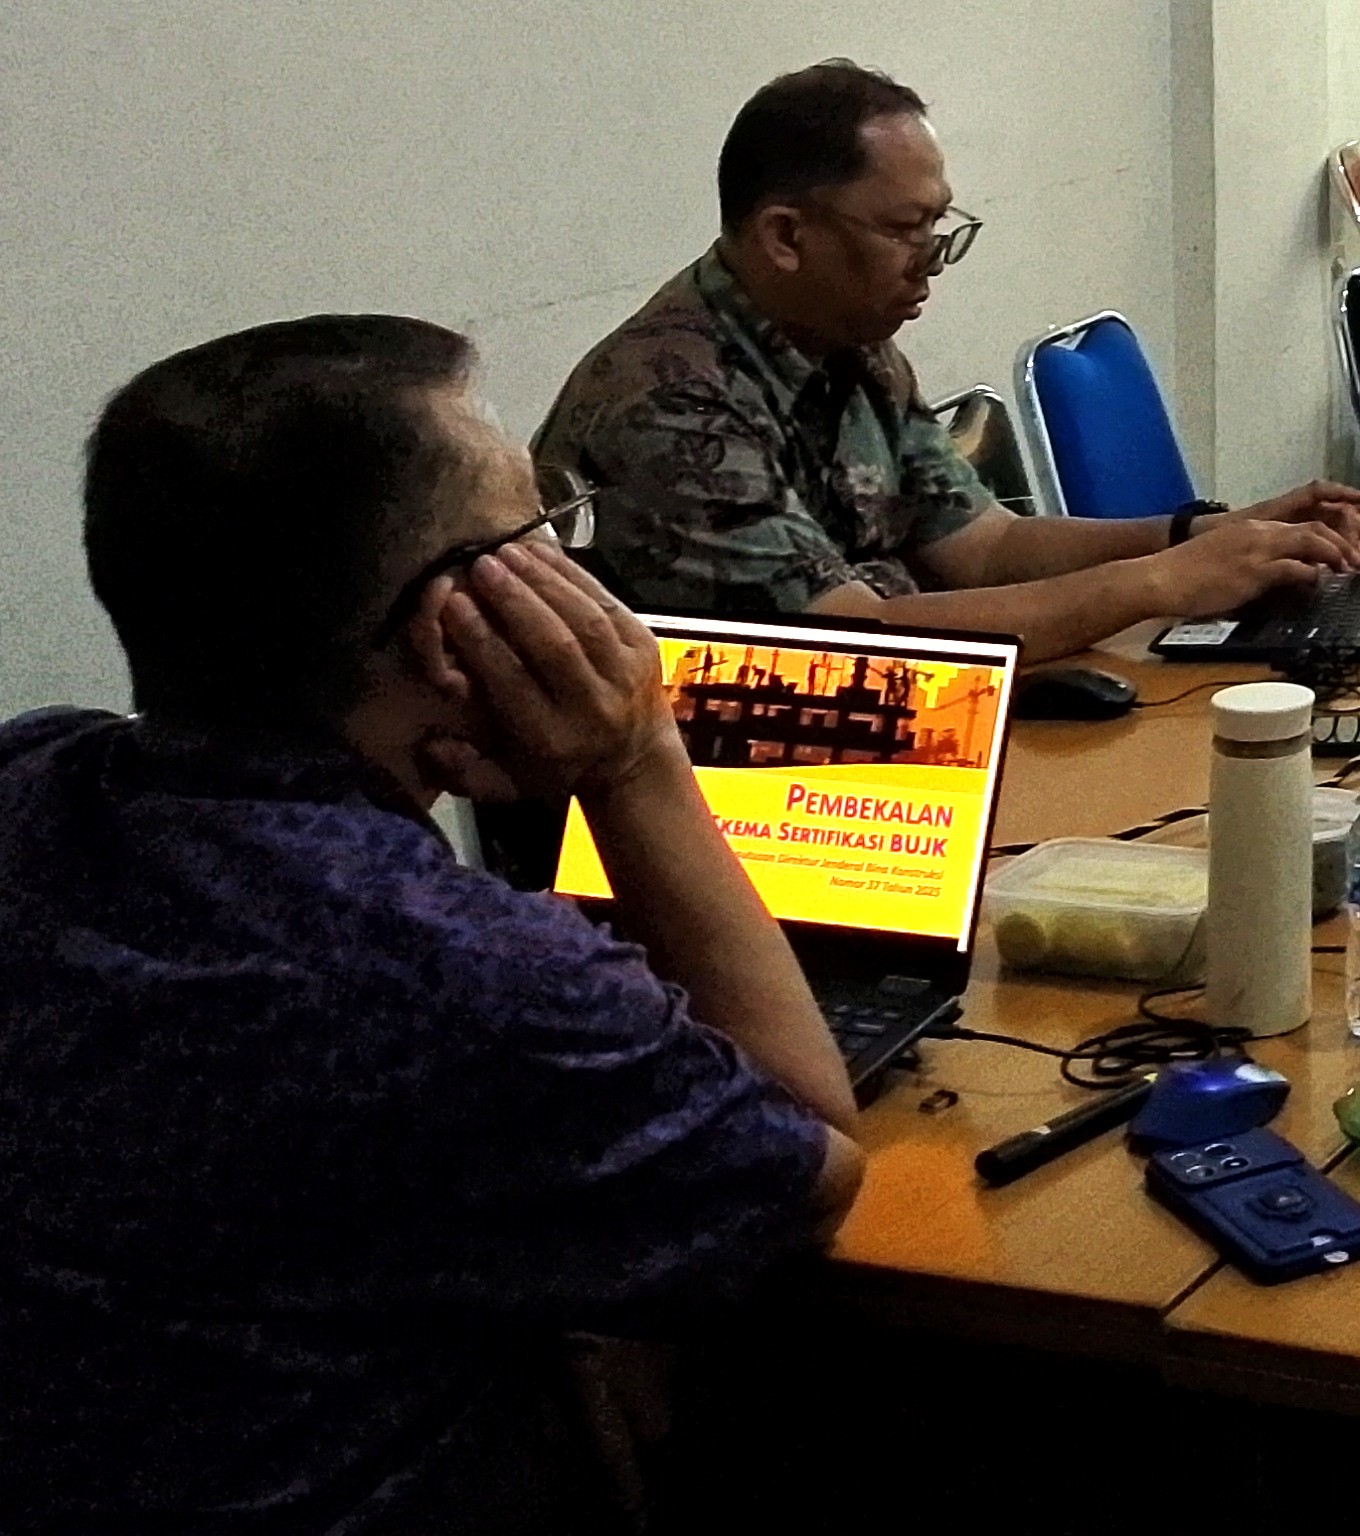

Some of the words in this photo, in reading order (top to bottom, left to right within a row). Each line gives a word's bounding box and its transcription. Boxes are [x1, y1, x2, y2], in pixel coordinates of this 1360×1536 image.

[786, 783, 954, 829] PEMBEKALAN
[777, 822, 885, 851] SERTIFIKASI
[890, 834, 949, 858] BUJK
